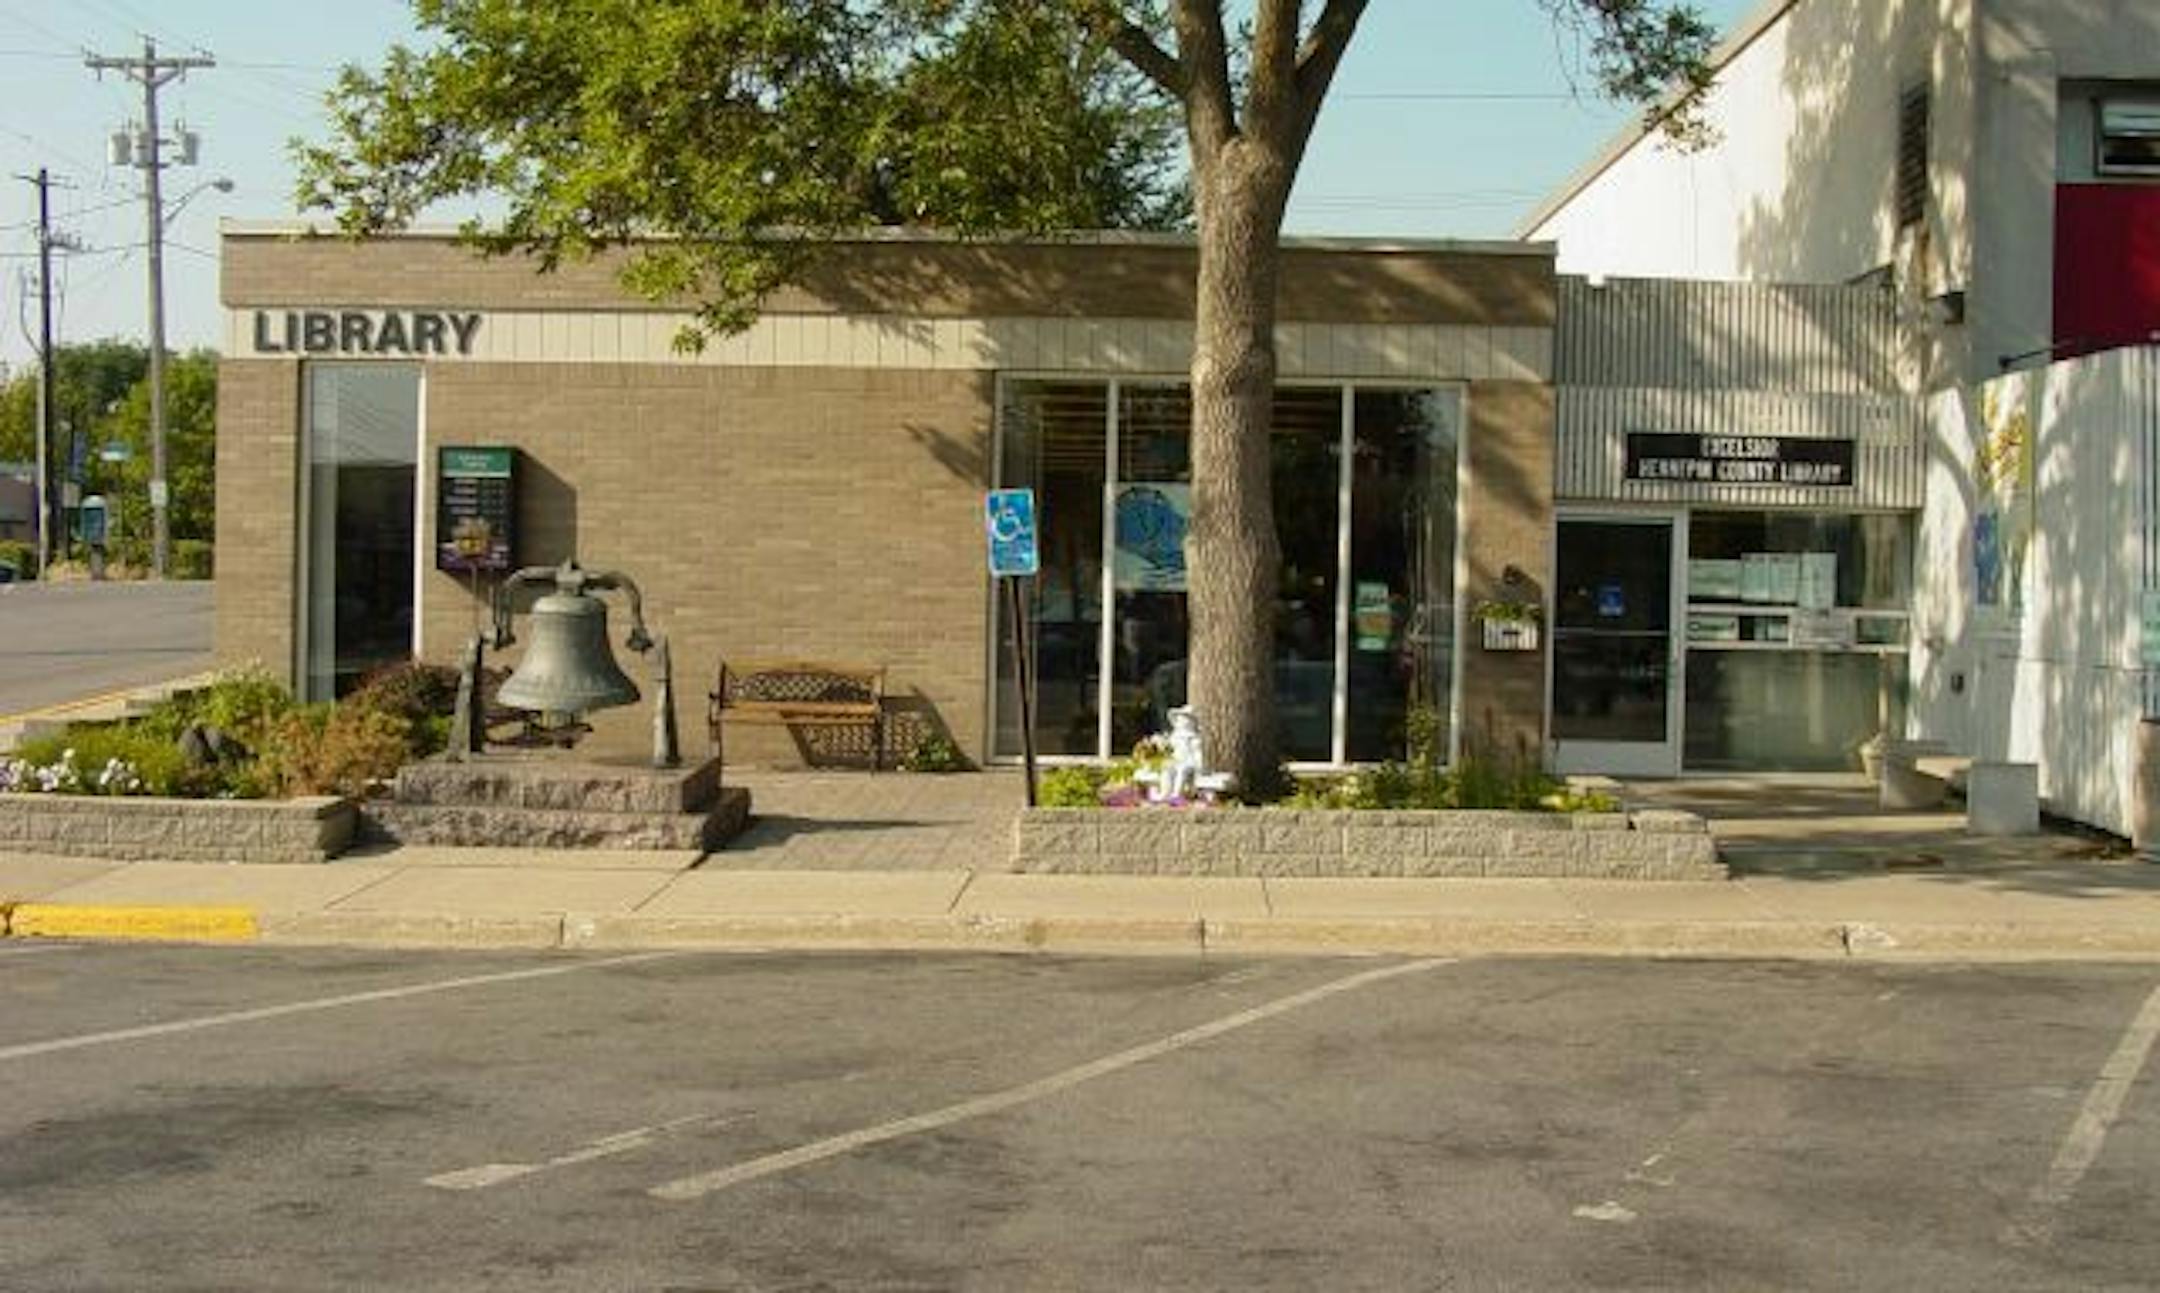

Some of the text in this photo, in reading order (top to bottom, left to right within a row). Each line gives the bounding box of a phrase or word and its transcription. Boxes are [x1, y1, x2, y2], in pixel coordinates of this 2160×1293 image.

[254, 310, 482, 354] LIBRARY
[1716, 461, 1778, 482] COUNTY
[1780, 463, 1842, 485] LIBRARY
